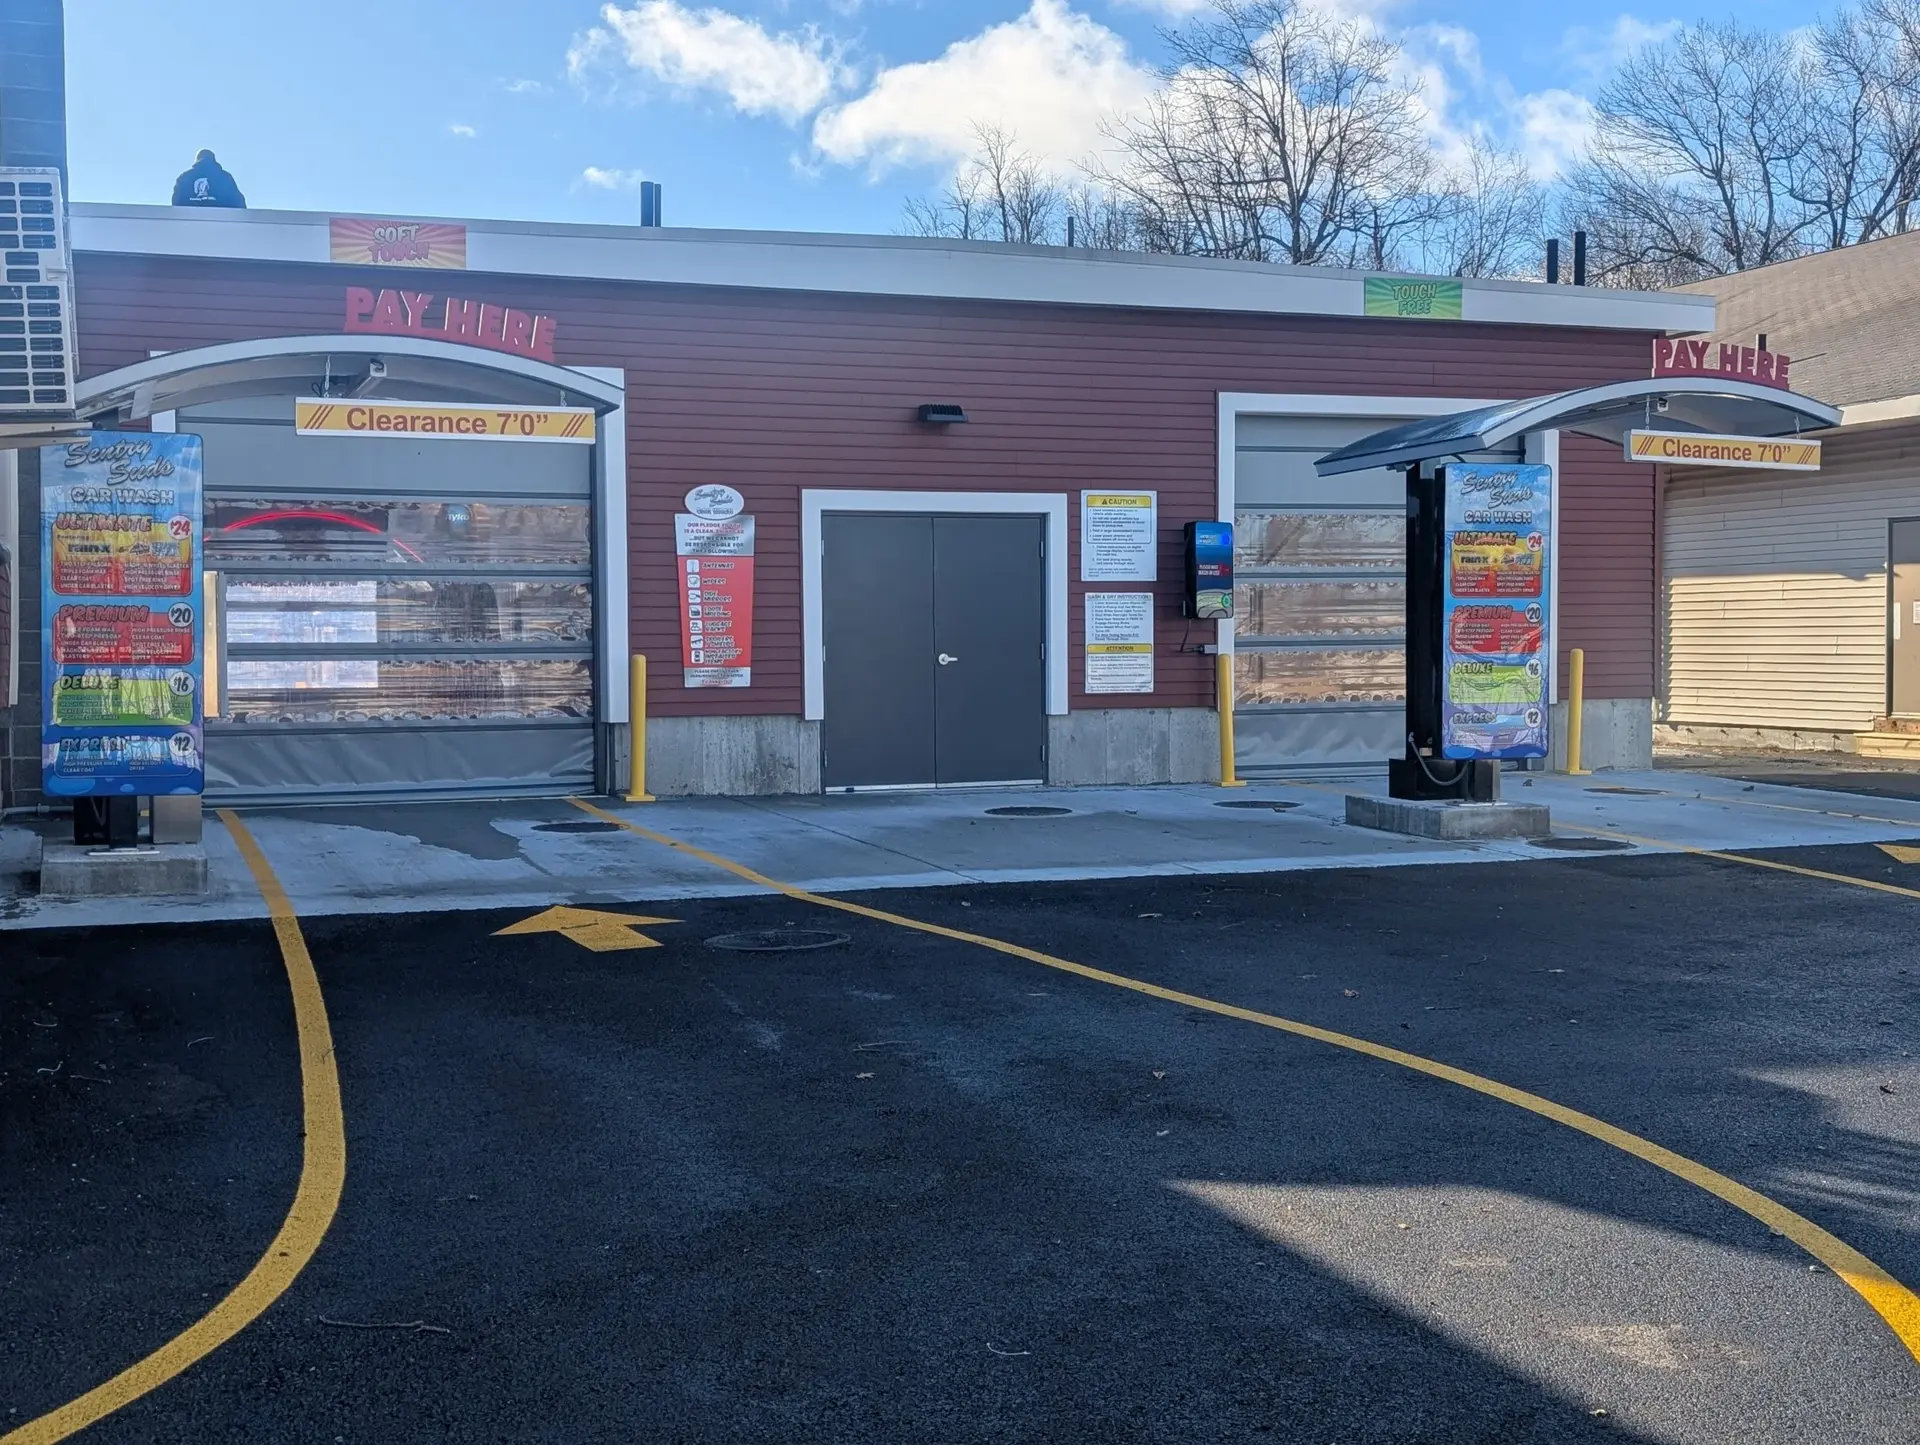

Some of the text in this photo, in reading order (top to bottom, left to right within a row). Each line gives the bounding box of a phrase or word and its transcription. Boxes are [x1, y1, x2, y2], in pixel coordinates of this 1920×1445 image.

[374, 224, 420, 244] SOFT
[368, 242, 430, 263] TOUCH
[1392, 282, 1437, 300] TOUCH
[1398, 299, 1432, 315] FREE
[344, 286, 557, 362] PAY HERE
[1653, 339, 1790, 386] PAY HERE
[346, 407, 487, 434] Clearance
[65, 440, 152, 467] Sentry
[1663, 439, 1751, 461] Clearance
[107, 457, 174, 485] Suds
[1461, 470, 1517, 494] Sentry
[71, 488, 174, 504] CAR WASH
[1488, 486, 1533, 509] Suds
[56, 512, 152, 532] ULTIMATE
[1464, 510, 1532, 524] CAR WASH
[170, 520, 190, 536] $24
[1454, 531, 1516, 546] ULTIMATE
[1528, 535, 1541, 548] $24
[59, 604, 150, 622] PREMIUM
[171, 607, 190, 623] $20
[1455, 604, 1513, 620] PREMIUM
[1527, 607, 1540, 619] $20
[1454, 662, 1493, 674] DELUXE
[60, 675, 120, 690] DELUXE
[174, 676, 189, 692] $16
[1453, 712, 1496, 724] EXPRESS
[59, 737, 127, 752] EXPRESS
[174, 737, 189, 752] $12
